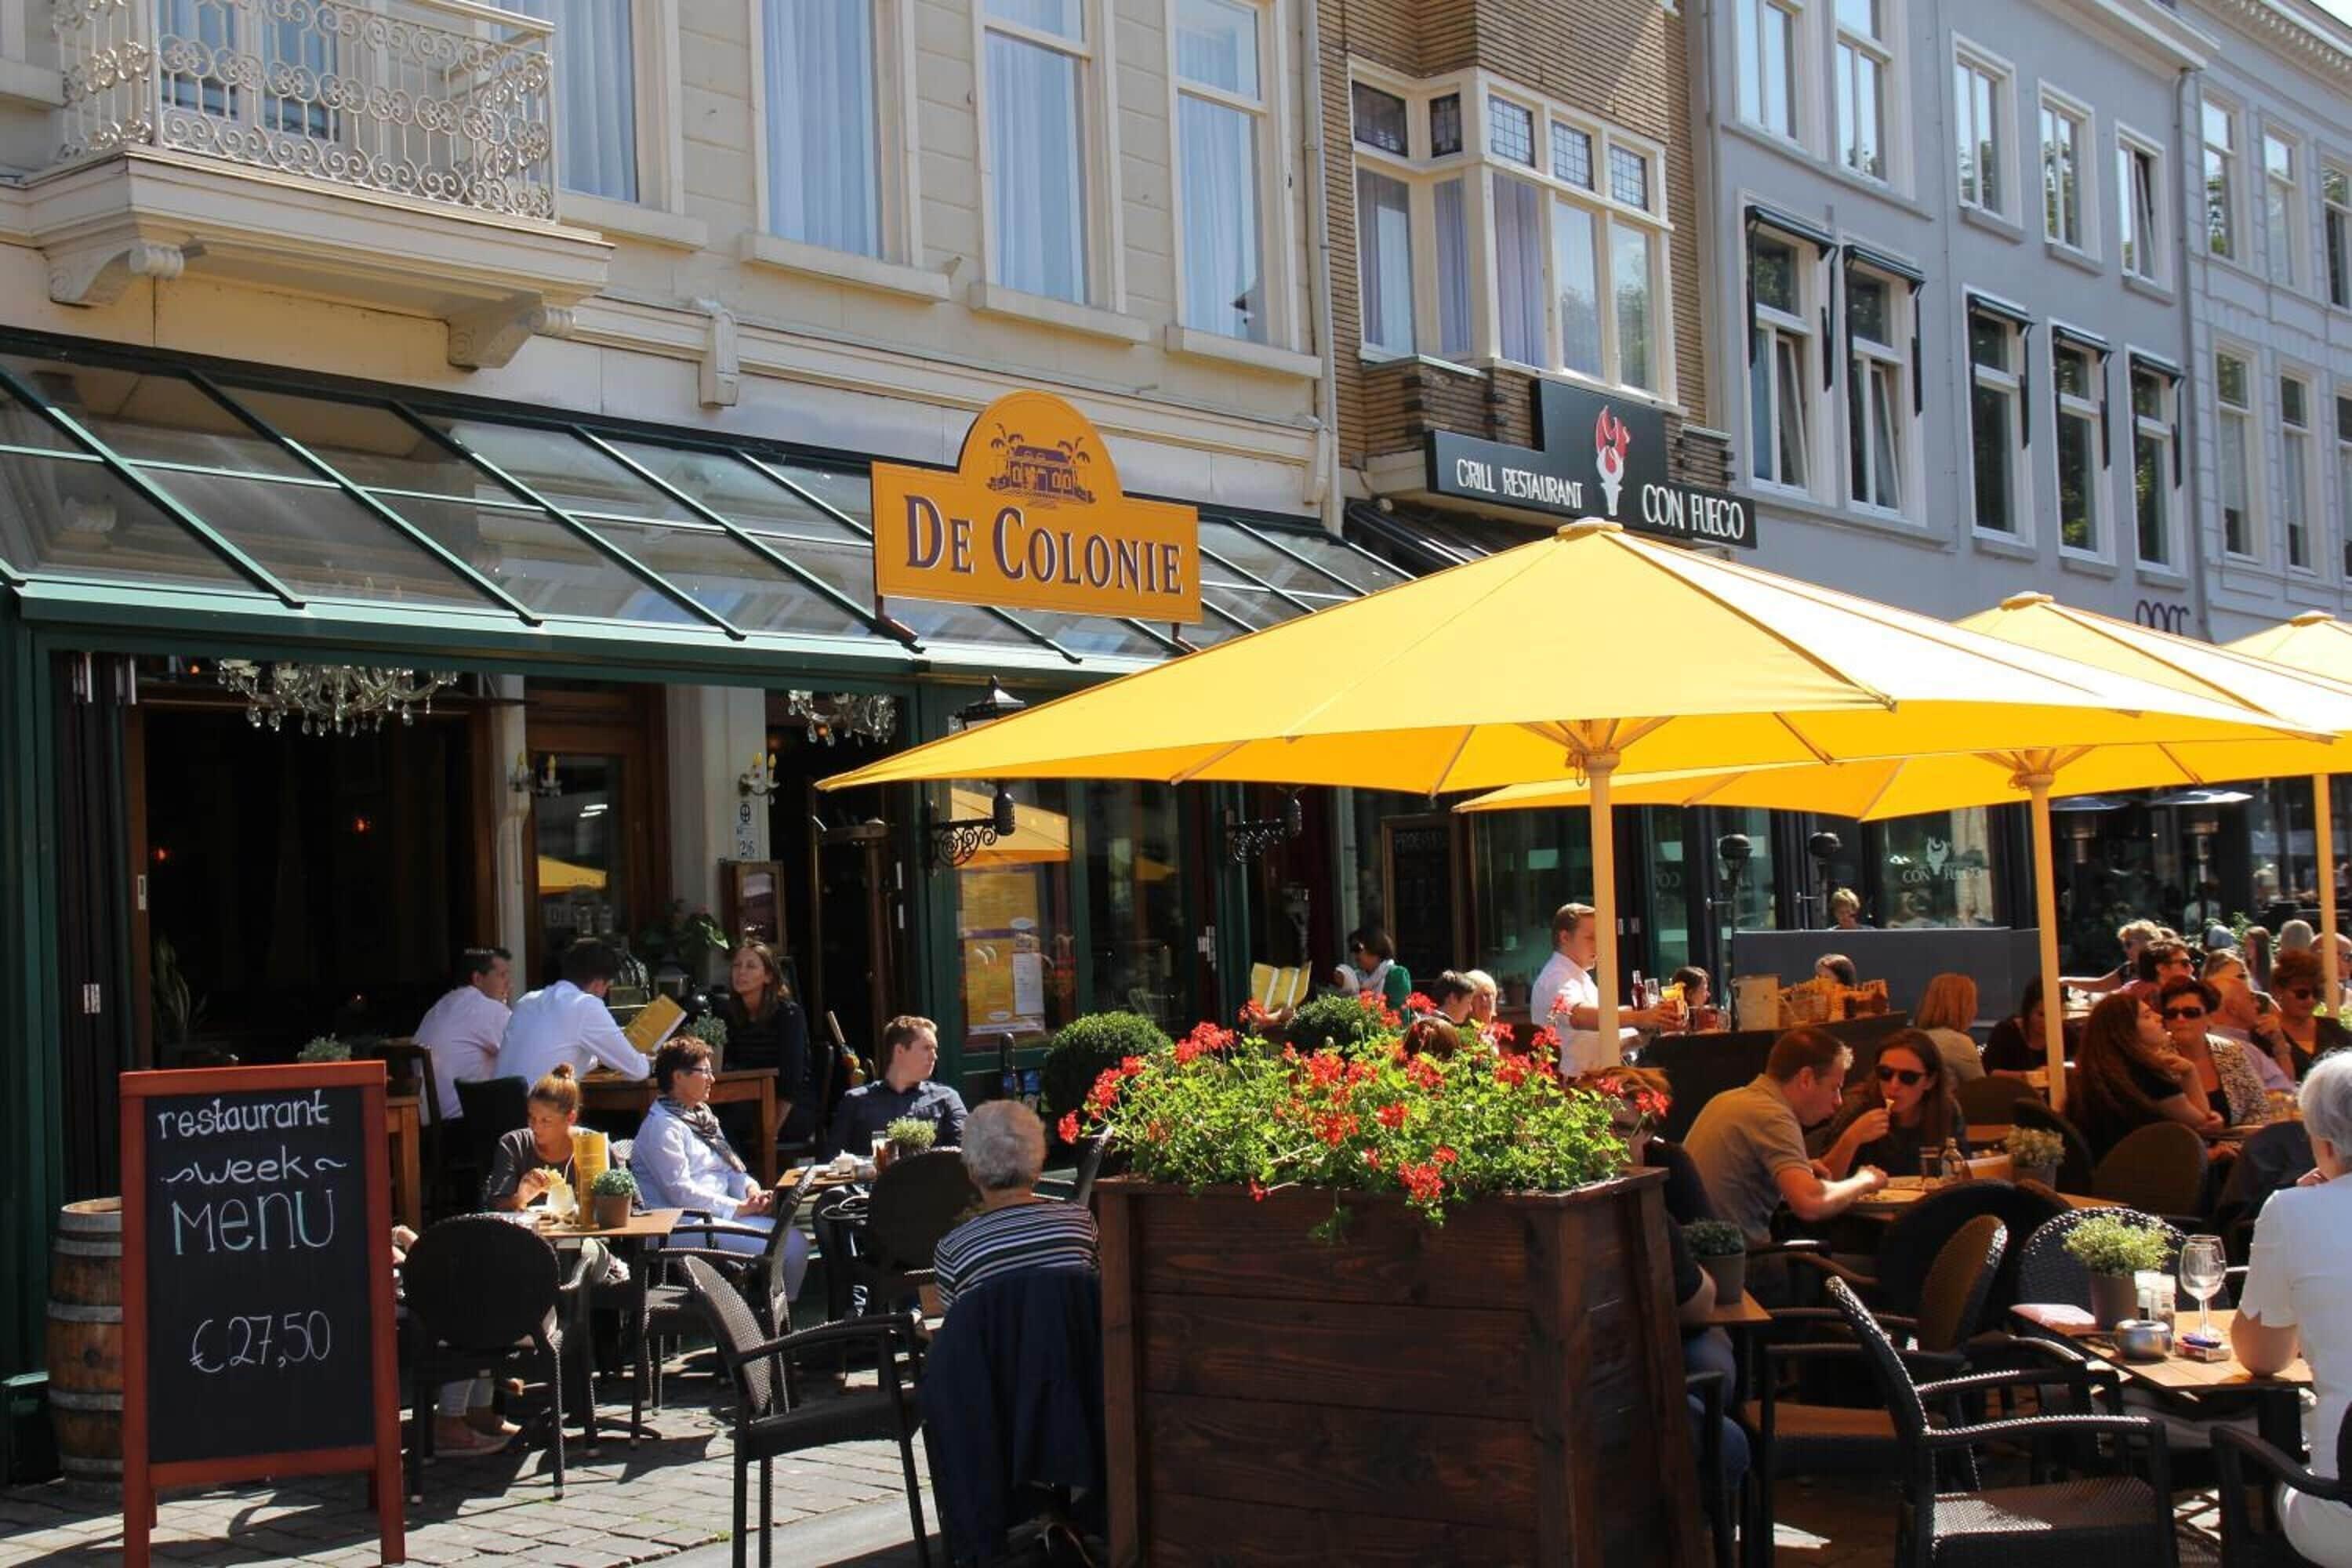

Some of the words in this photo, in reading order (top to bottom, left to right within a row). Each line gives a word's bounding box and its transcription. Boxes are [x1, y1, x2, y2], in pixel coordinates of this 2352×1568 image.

[1456, 458, 1497, 493] GRILL
[1501, 466, 1584, 509] RESTAURANT
[1642, 483, 1685, 530] CON
[1690, 493, 1744, 540] FUEGO
[158, 1088, 331, 1140] restaurant
[194, 1144, 310, 1185] week
[189, 1310, 331, 1373] €27,50
